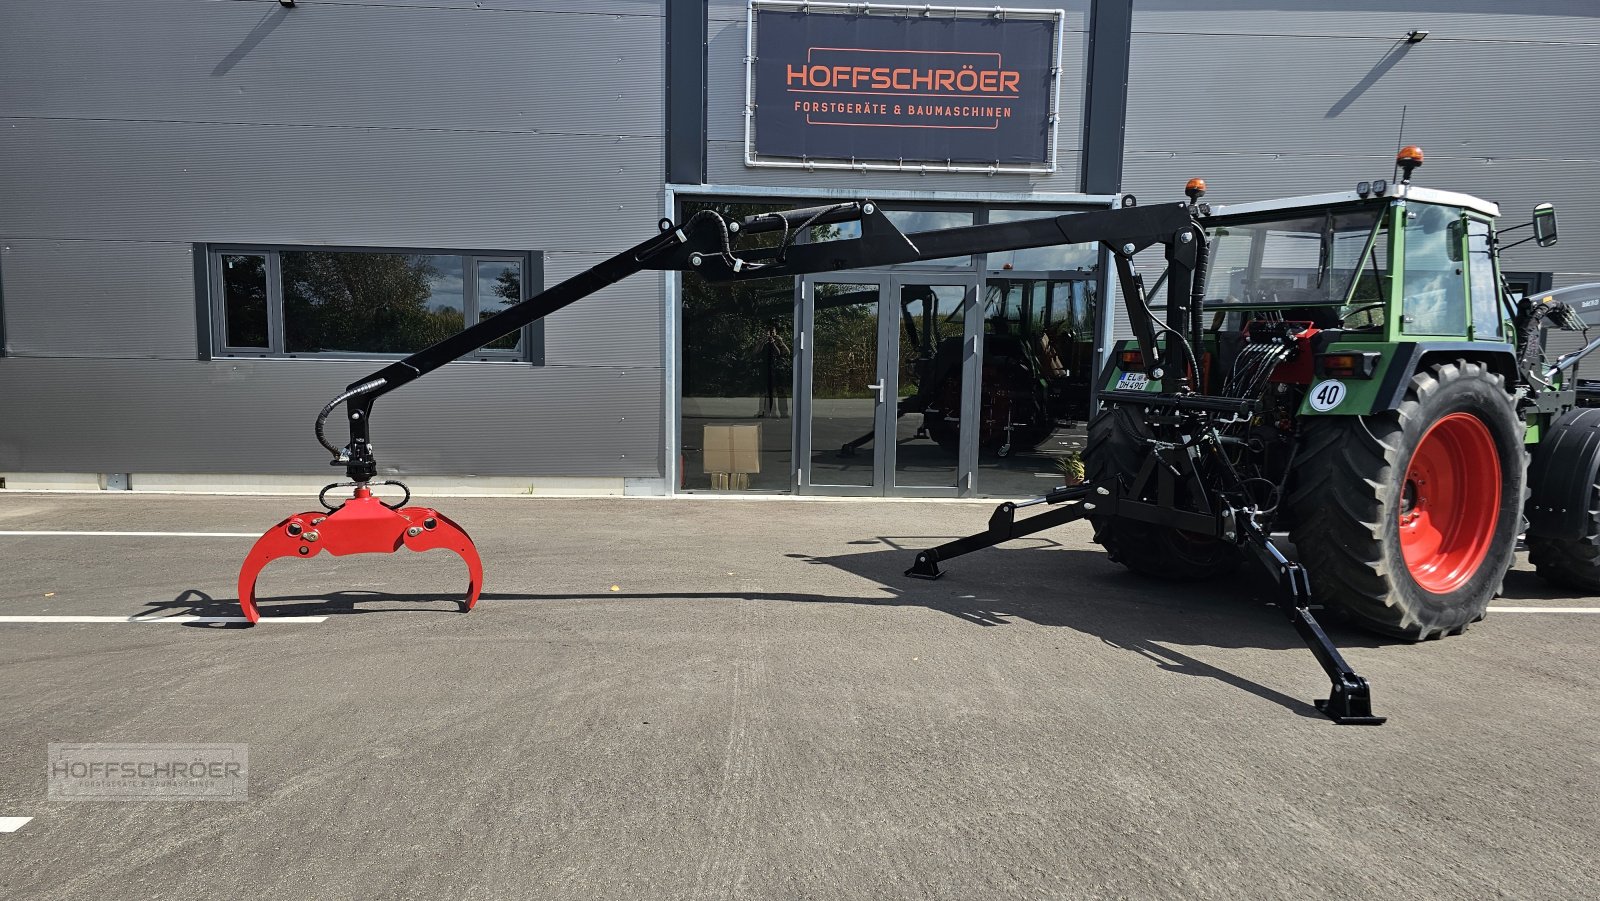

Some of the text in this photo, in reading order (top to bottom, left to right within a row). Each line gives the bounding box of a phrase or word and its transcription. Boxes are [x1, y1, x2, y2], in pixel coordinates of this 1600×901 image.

[786, 64, 1020, 92] HOFFSCHRÖER
[794, 101, 1012, 118] FORSTGERÄTE & BAUMASCHINEN
[1127, 373, 1137, 381] EL
[1316, 385, 1340, 405] 40
